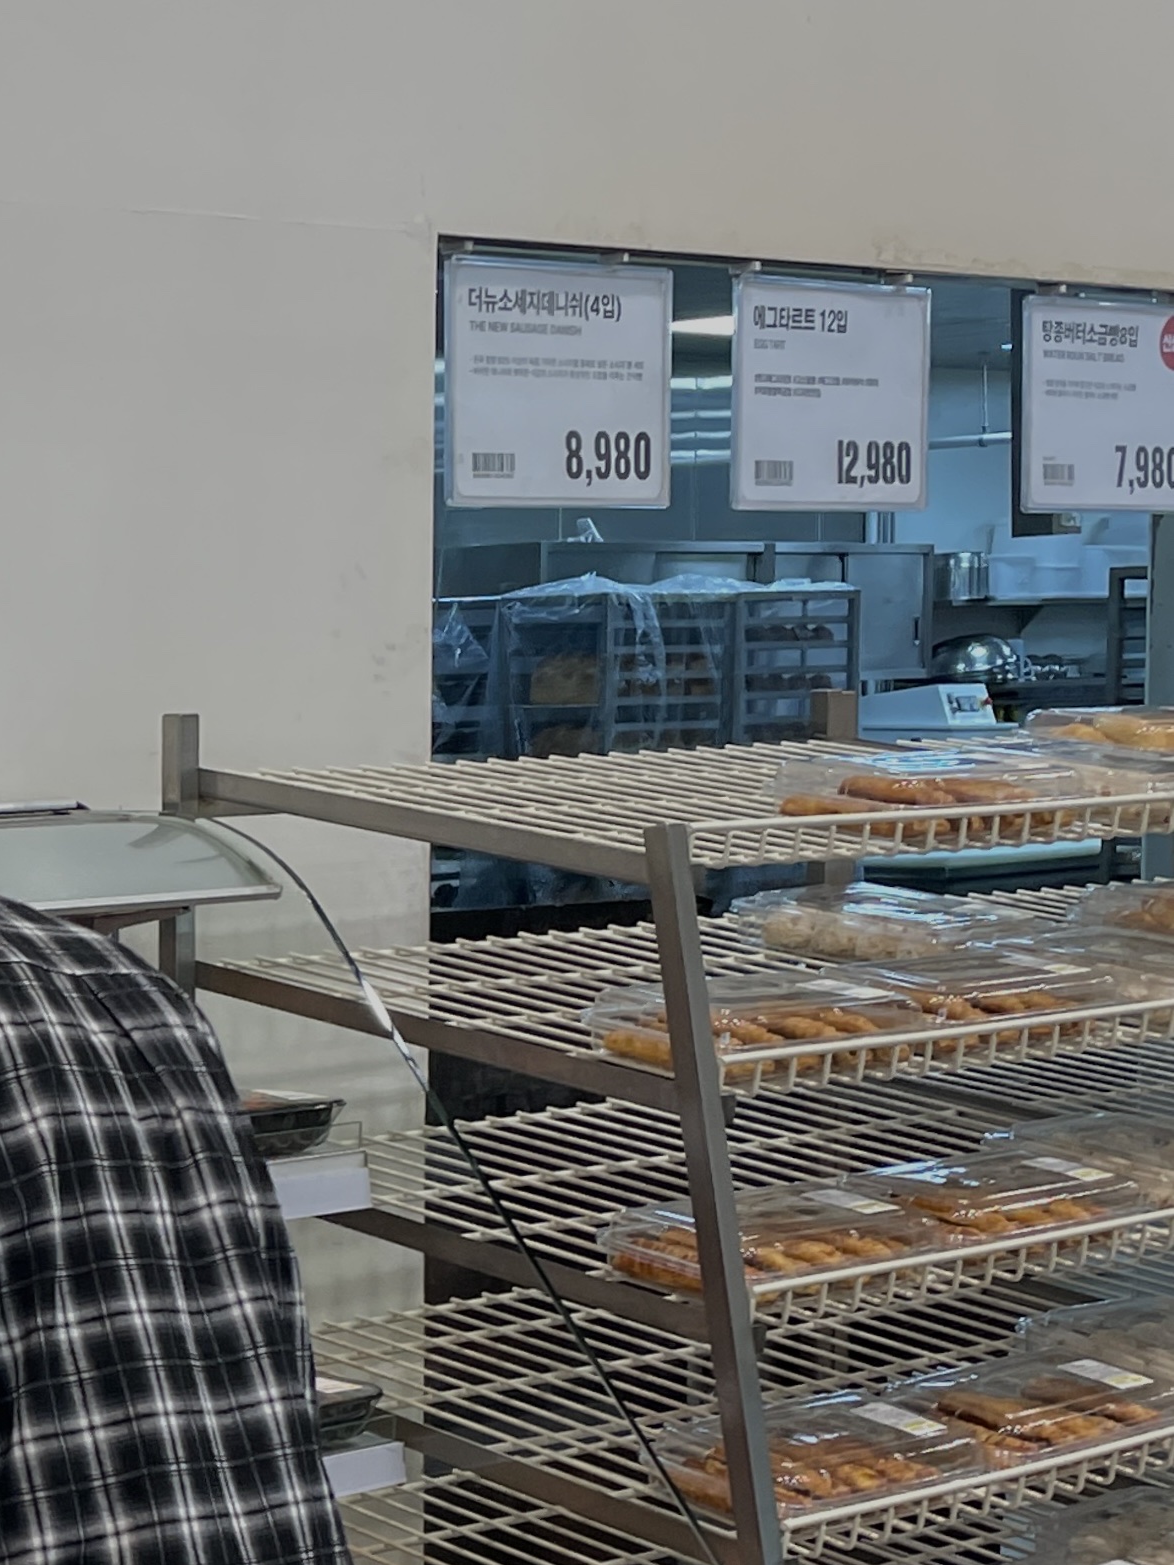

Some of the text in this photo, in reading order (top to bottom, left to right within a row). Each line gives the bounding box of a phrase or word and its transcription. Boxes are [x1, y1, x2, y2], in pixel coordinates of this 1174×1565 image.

[468, 286, 622, 322] 더뉴소세지데니쉬(4입)
[753, 305, 848, 334] 에그타르트 12입
[565, 430, 652, 486] 8,980
[837, 439, 911, 488] 12,980
